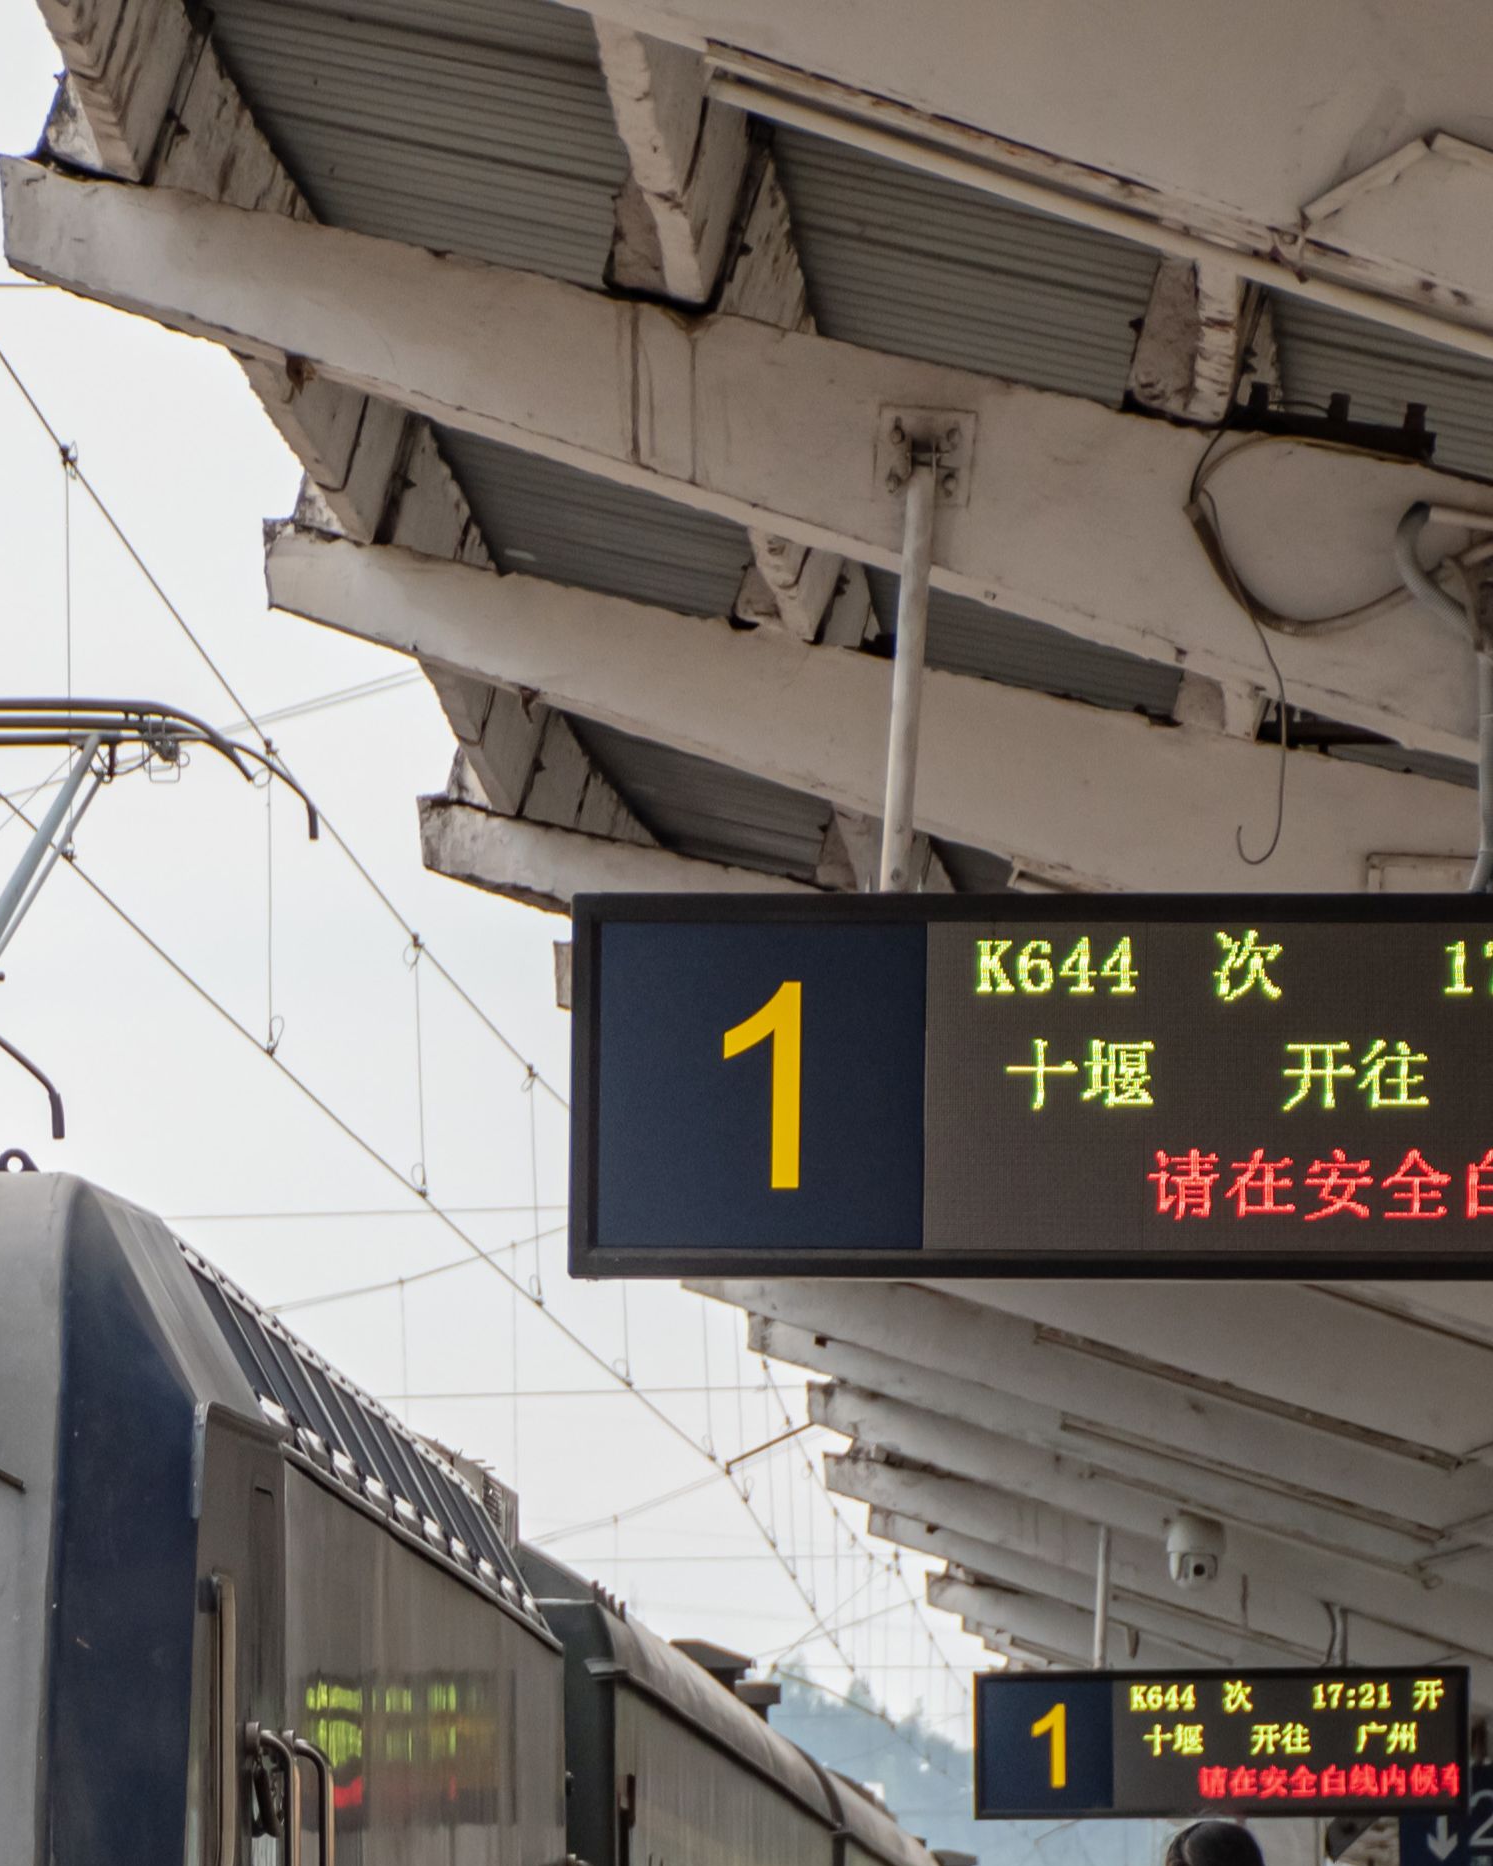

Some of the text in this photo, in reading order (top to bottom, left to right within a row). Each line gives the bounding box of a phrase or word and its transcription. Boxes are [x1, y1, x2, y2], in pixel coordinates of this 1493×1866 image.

[975, 936, 1139, 995] K644
[1212, 929, 1283, 1002] 次
[723, 981, 802, 1189] 1
[1005, 1038, 1155, 1111] 十堰
[1282, 1039, 1431, 1112] 开往
[1129, 1679, 1444, 1713] K644 次 17:21 开
[1031, 1703, 1066, 1788] 1
[1142, 1721, 1418, 1757] 十堰 开往 广州
